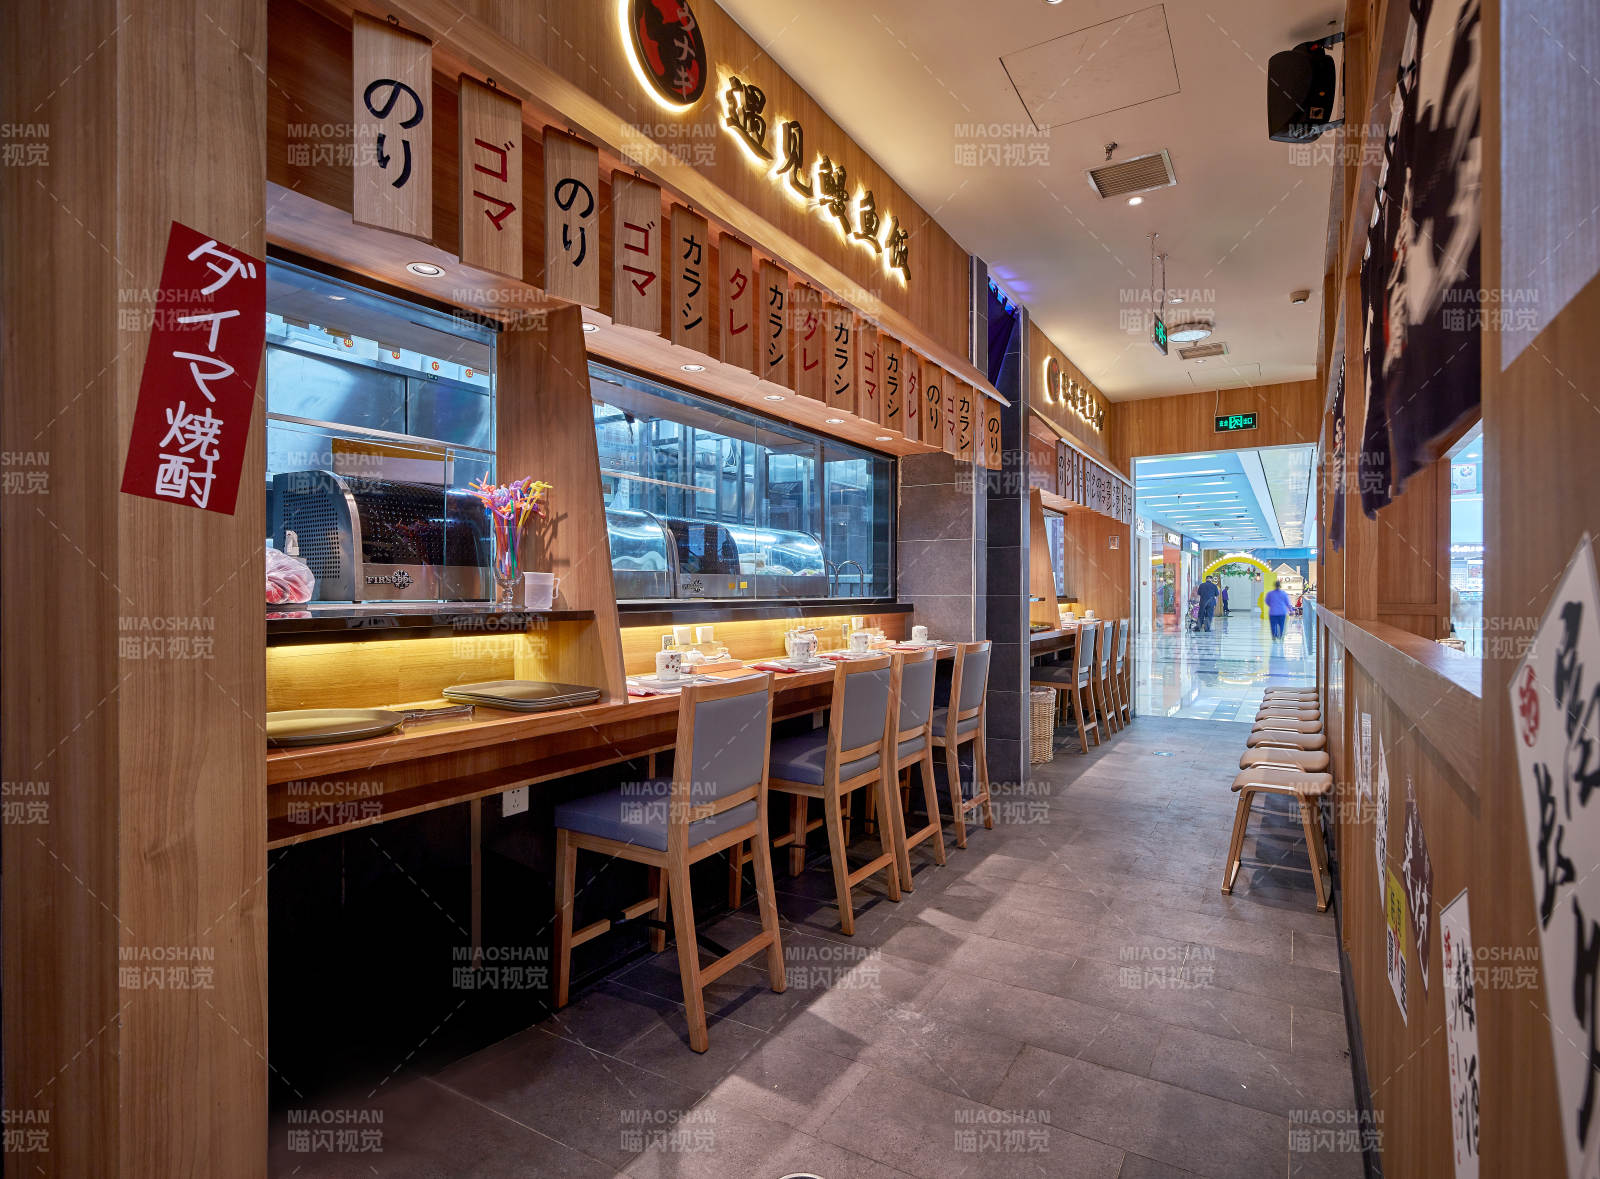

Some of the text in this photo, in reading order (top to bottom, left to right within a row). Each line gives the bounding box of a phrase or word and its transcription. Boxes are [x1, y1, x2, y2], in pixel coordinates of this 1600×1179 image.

[363, 78, 424, 189] のり
[473, 137, 517, 231] ゴマ
[554, 178, 595, 267] のり
[622, 221, 656, 297] ゴマ
[682, 235, 703, 331] カラシ
[729, 268, 748, 336] タレ
[769, 284, 784, 367] カラシ
[803, 311, 818, 371] タレ
[834, 322, 849, 395] カラシ
[155, 240, 257, 509] ダイマ焼酎
[864, 351, 876, 400] ゴマ
[887, 353, 899, 418] カラシ
[908, 371, 917, 418] タレ
[927, 384, 940, 430] のり
